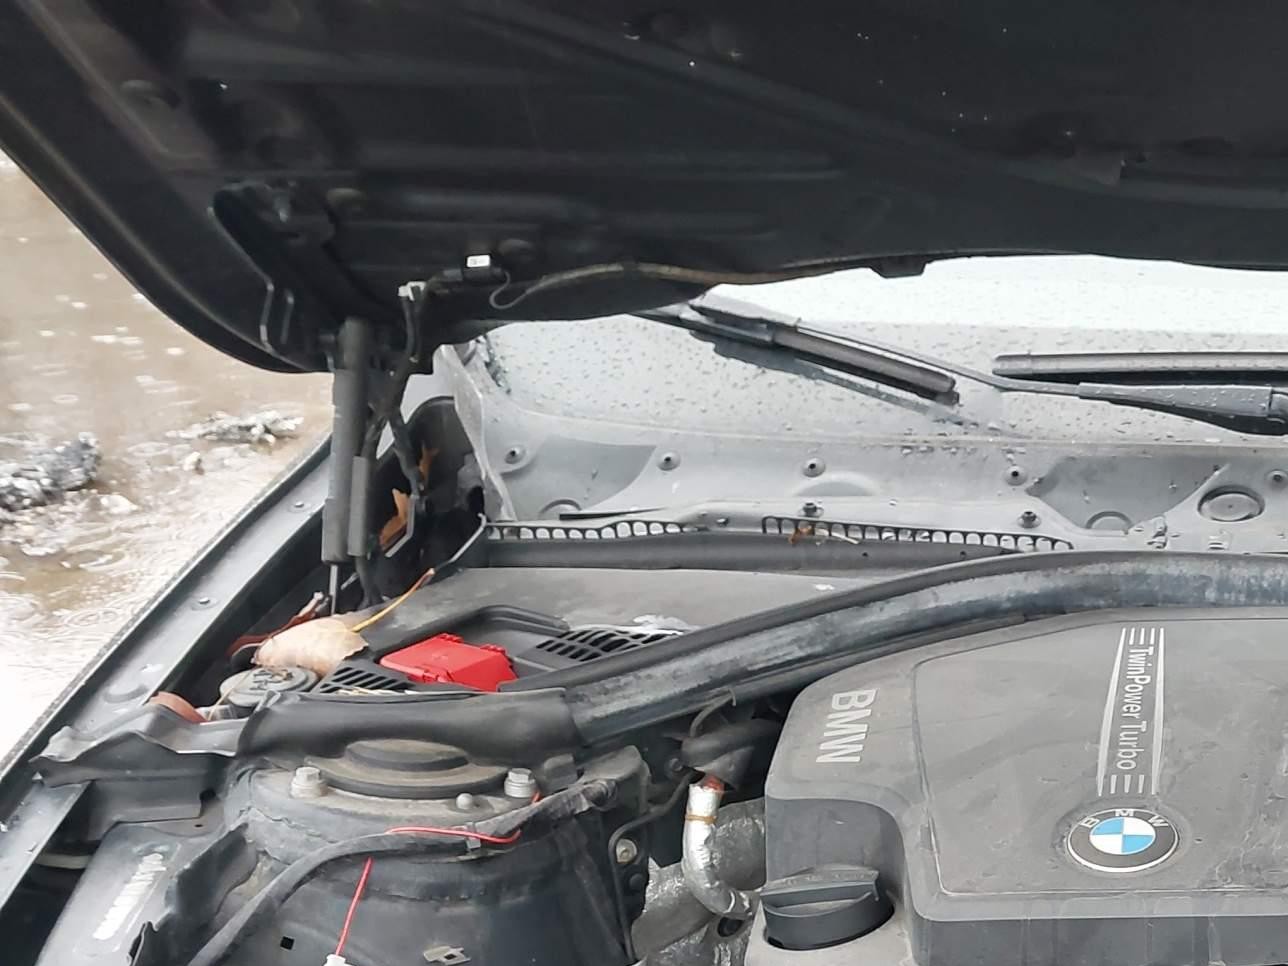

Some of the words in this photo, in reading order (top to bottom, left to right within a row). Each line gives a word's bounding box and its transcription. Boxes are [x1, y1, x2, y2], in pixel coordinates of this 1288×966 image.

[1120, 646, 1155, 719] TwinPower
[816, 689, 877, 763] BMW
[1116, 720, 1148, 770] Turbo
[1079, 808, 1169, 828] BMW
